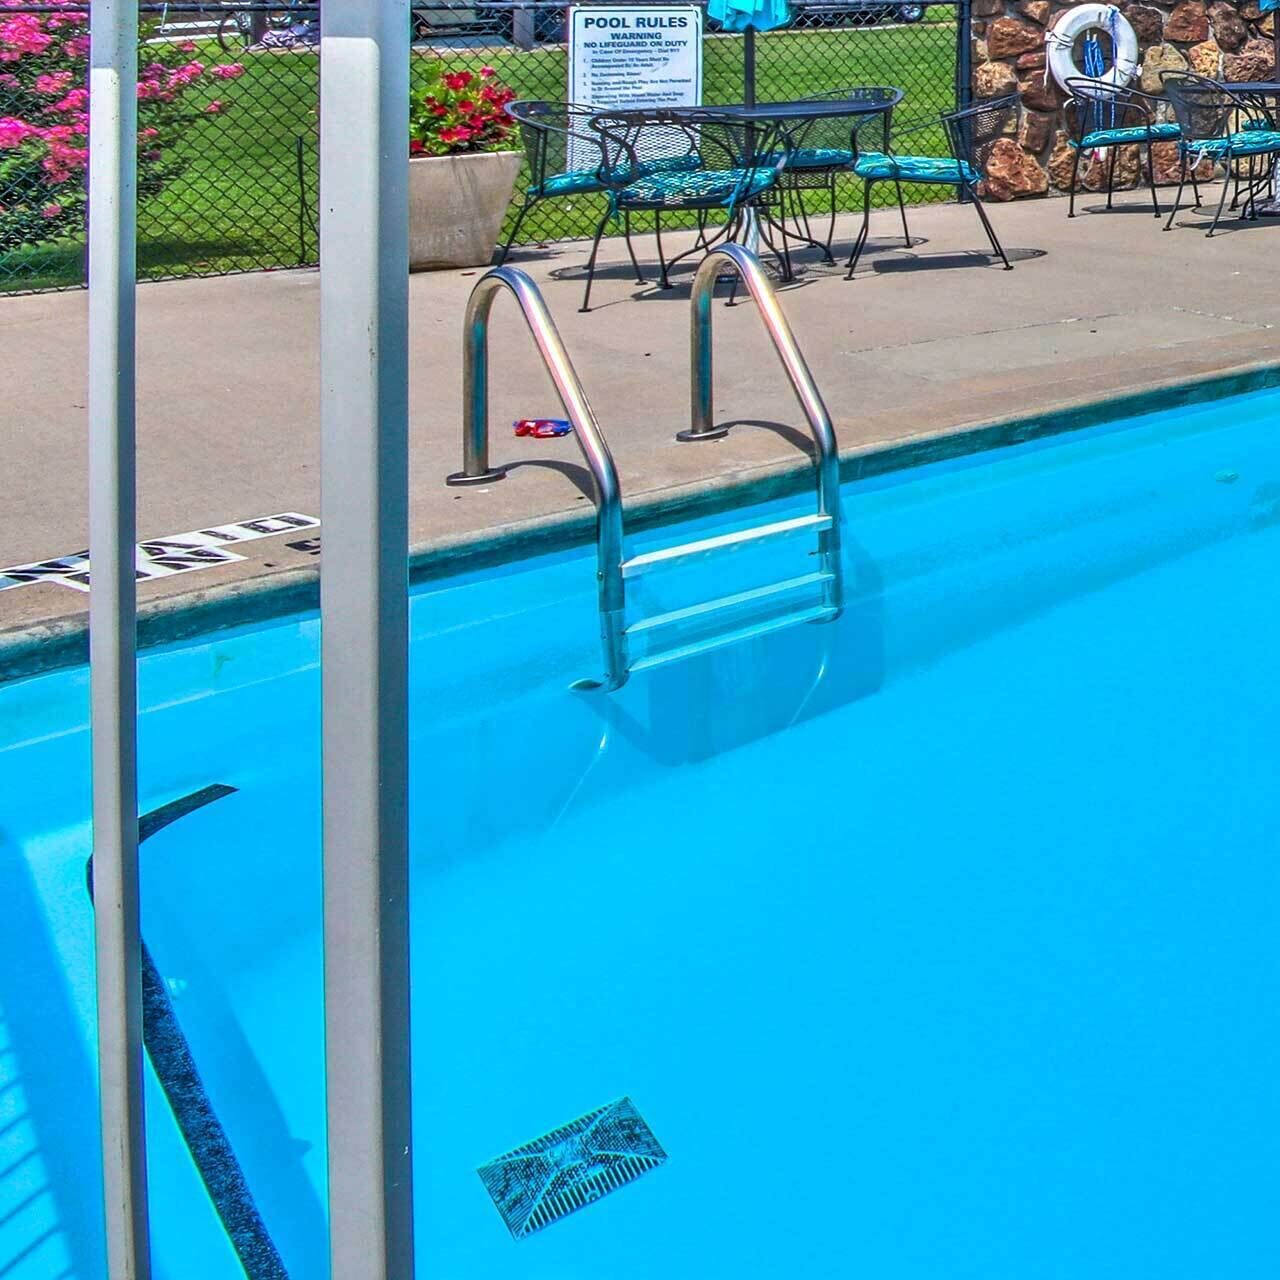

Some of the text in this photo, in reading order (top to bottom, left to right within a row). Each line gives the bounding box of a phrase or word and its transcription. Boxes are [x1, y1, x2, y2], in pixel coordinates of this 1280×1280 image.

[584, 17, 688, 29] POOL RULES
[610, 32, 662, 40] WARNING
